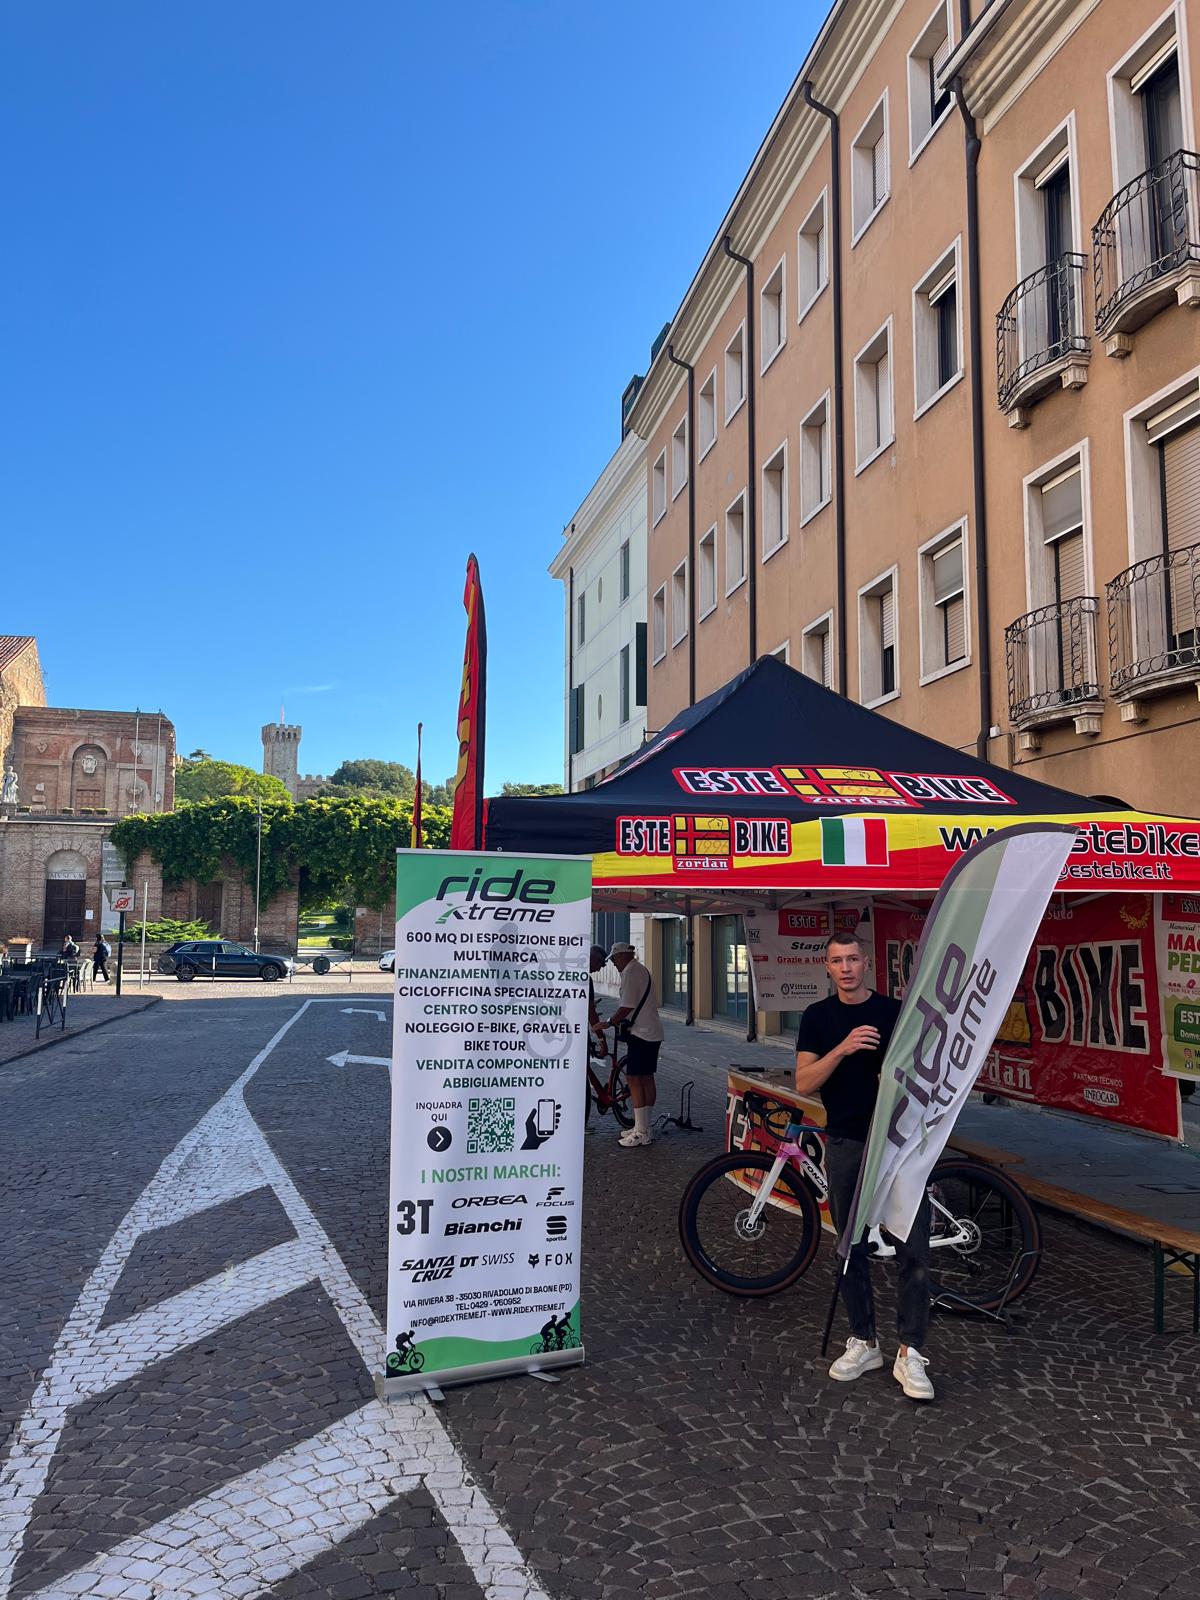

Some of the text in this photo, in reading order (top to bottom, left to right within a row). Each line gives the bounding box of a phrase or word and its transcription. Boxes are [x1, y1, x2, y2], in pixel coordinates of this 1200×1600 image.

[681, 770, 789, 794] ESTE
[891, 774, 1006, 803] BIKE
[620, 819, 671, 852] ESTE
[735, 820, 789, 853] BIKE
[676, 857, 729, 869] zordan
[436, 868, 556, 905] ride
[788, 914, 817, 928] ESTE
[406, 932, 584, 947] 600 MQ DI ESPOSIZIONE BICI
[453, 950, 539, 963] MULTIMARCA
[777, 956, 803, 964] Grazie
[398, 968, 589, 982] FINANZIAMENTI A TASSO ZERO
[399, 986, 588, 999] CICLOFFICINA SPECIALIZZATA
[1034, 940, 1150, 1055] BIKE
[423, 1004, 562, 1016] CENTRO SOSPENSIONI
[405, 1022, 581, 1035] NOLEGGIO E-BIKE, GRAVEL E
[464, 1040, 526, 1051] BIKE TOUR
[887, 942, 967, 1149] ride
[416, 1058, 570, 1071] VENDITA COMPONENTI E
[443, 1076, 545, 1089] ABBIGLIAMENTO
[1072, 1071, 1123, 1088] PARTNER TECNICO
[1085, 1088, 1118, 1104] INFOCARS
[415, 1101, 463, 1110] INQUADRA
[431, 1113, 448, 1122] QUI
[421, 1164, 561, 1184] I NOSTRI MARCHI:
[451, 1194, 529, 1209] ORBEA
[536, 1200, 575, 1208] FOCUS
[396, 1199, 434, 1236] 3T
[444, 1218, 523, 1236] Bianchi
[399, 1255, 457, 1272] SANTA
[459, 1252, 515, 1268] DT SWISS
[545, 1253, 573, 1266] FOX
[411, 1268, 453, 1283] CRUZ
[403, 1300, 417, 1309] VIA
[418, 1297, 444, 1307] RIVIERA
[445, 1295, 454, 1303] 38
[459, 1292, 482, 1302] 35030
[482, 1287, 524, 1298] RIVADOLMO
[525, 1286, 533, 1294] DI
[534, 1285, 558, 1293] BAONE
[558, 1283, 573, 1293] (PD)
[456, 1303, 470, 1311] TEL:
[470, 1301, 489, 1310] 0429
